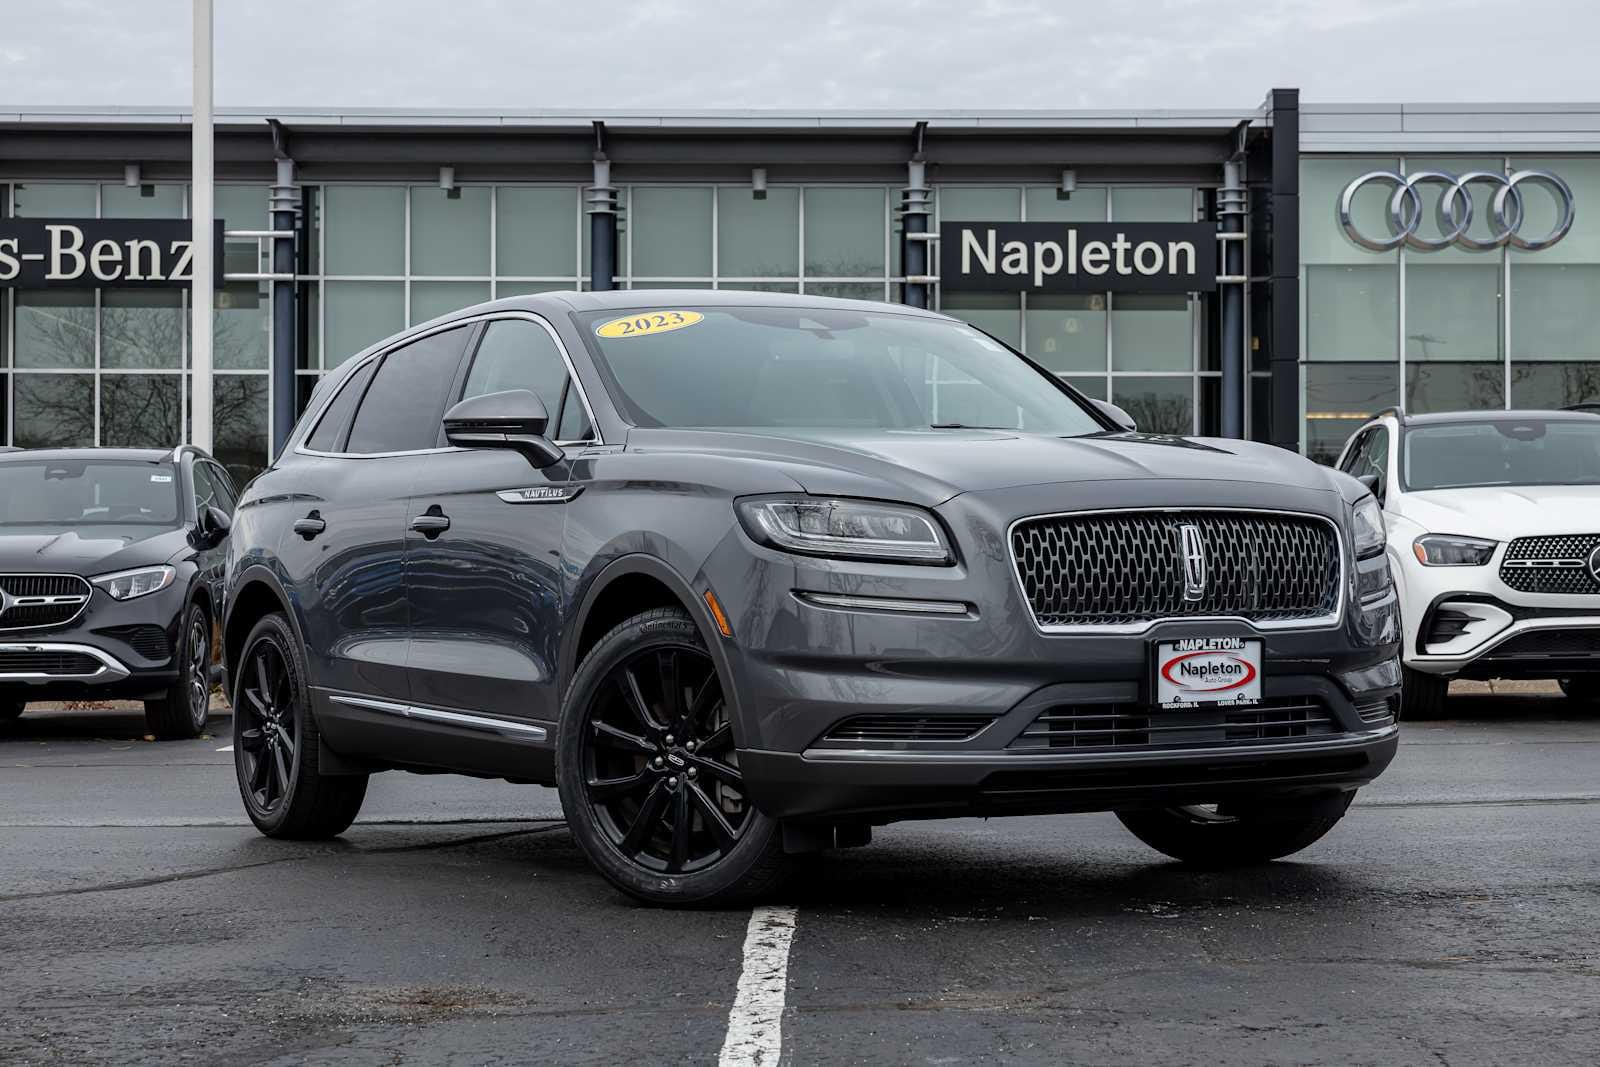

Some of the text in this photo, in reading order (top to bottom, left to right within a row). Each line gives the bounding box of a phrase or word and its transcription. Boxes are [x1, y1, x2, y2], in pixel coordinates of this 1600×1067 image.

[961, 229, 1196, 287] Napleton
[618, 312, 684, 334] 2023
[524, 488, 563, 498] NAUTILUS
[1180, 638, 1240, 651] NAPLETON
[1180, 661, 1241, 678] Napleton
